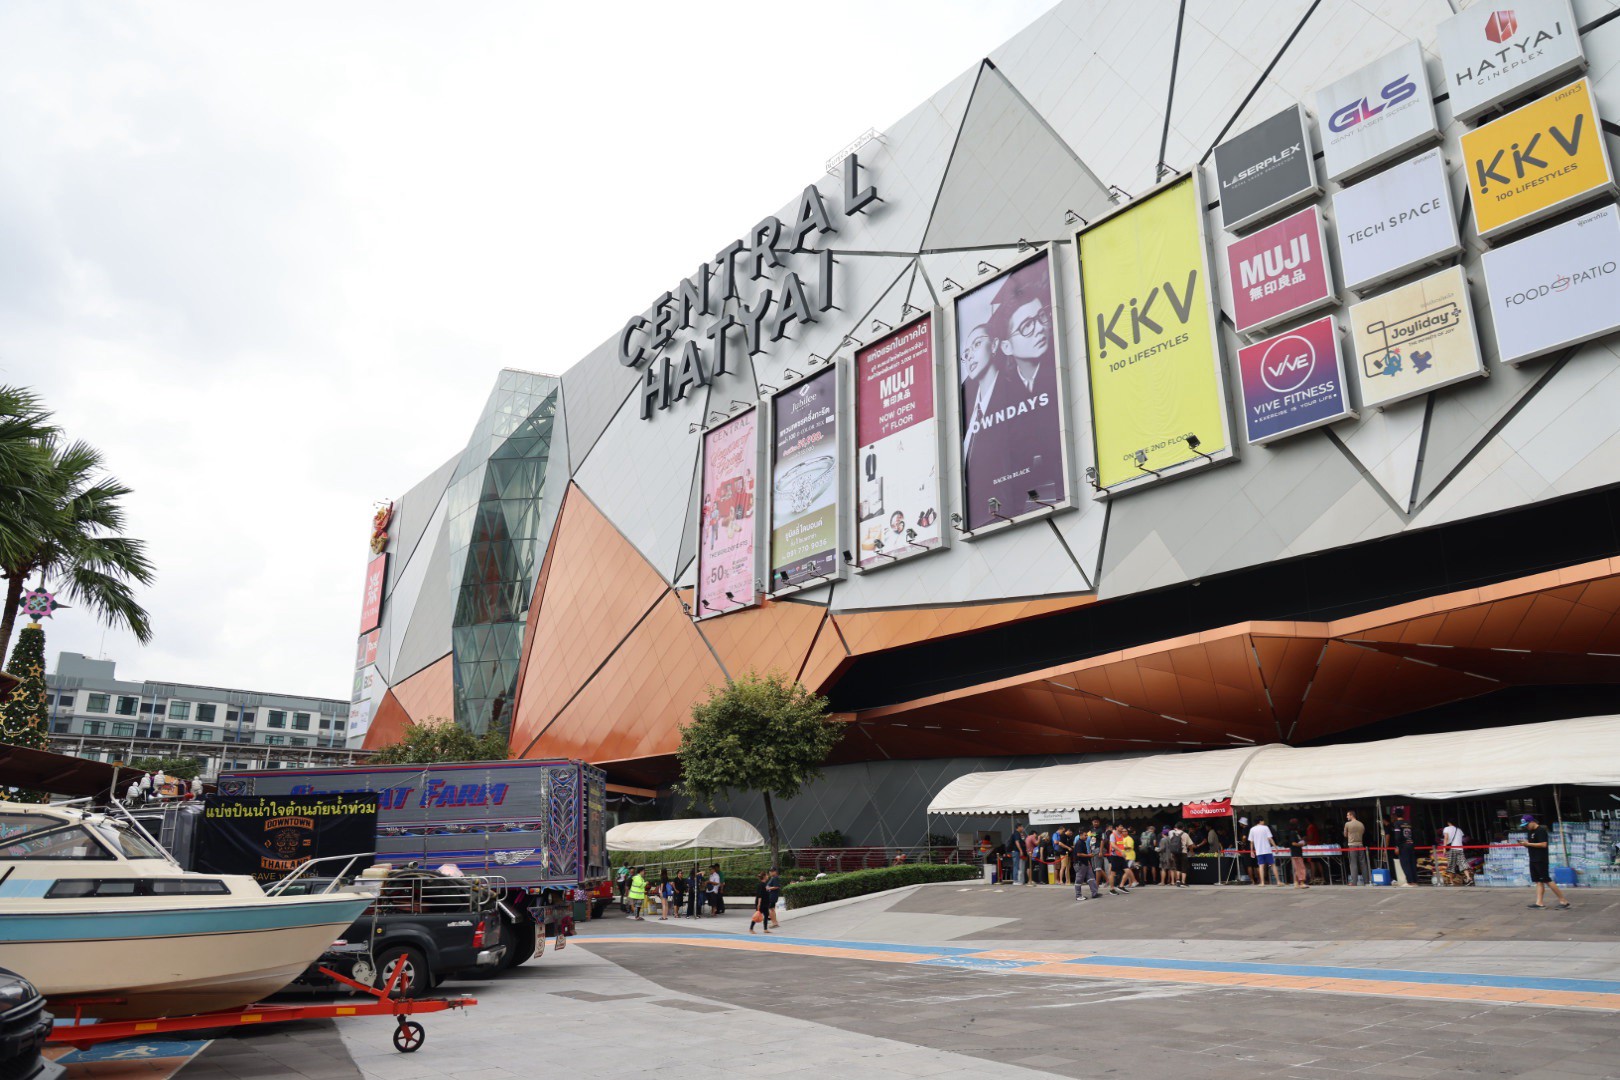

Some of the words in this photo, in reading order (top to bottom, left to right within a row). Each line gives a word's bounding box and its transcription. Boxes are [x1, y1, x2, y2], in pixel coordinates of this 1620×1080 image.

[1456, 22, 1562, 85] HATYAI
[1477, 49, 1544, 85] CINEPLEX
[1328, 73, 1416, 133] GLS
[1223, 142, 1301, 188] LASERPLEX
[1476, 113, 1584, 194] KKV
[1496, 190, 1513, 202] 100
[1516, 163, 1578, 193] LIFESTYLES
[1348, 222, 1385, 244] TECH
[1389, 198, 1440, 228] SPACE
[619, 153, 877, 367] CENTRAL
[1239, 233, 1311, 289] MUJI
[1249, 268, 1306, 302] 無印良品
[1505, 285, 1549, 308] FOOD
[1572, 262, 1617, 285] PATIO
[1097, 269, 1197, 359] KKV
[1391, 312, 1449, 339] Joyliday
[640, 249, 834, 420] HATYAI
[1109, 359, 1126, 373] 100
[1128, 333, 1189, 365] LIFESTYLES
[1268, 353, 1309, 377] VIVE
[880, 365, 914, 399] MUJI
[1253, 398, 1281, 415] VIVE
[1284, 381, 1335, 406] FITNESS
[791, 393, 817, 414] Jubilee
[879, 410, 895, 424] NOW
[896, 401, 915, 415] OPEN
[972, 393, 1049, 434] OWNDAYS
[1300, 399, 1317, 408] YOUR
[1319, 394, 1332, 403] LIFE
[891, 414, 913, 430] FLOOR
[1123, 452, 1134, 461] ON
[1151, 441, 1166, 452] 2ND
[1012, 467, 1030, 478] BLACK
[206, 795, 376, 818] แบ่งปันน้ำใจต้านภัยน้ำท่วม
[420, 779, 509, 807] FARM
[267, 818, 311, 828] DOWNTOWN
[251, 872, 276, 880] SAVE
